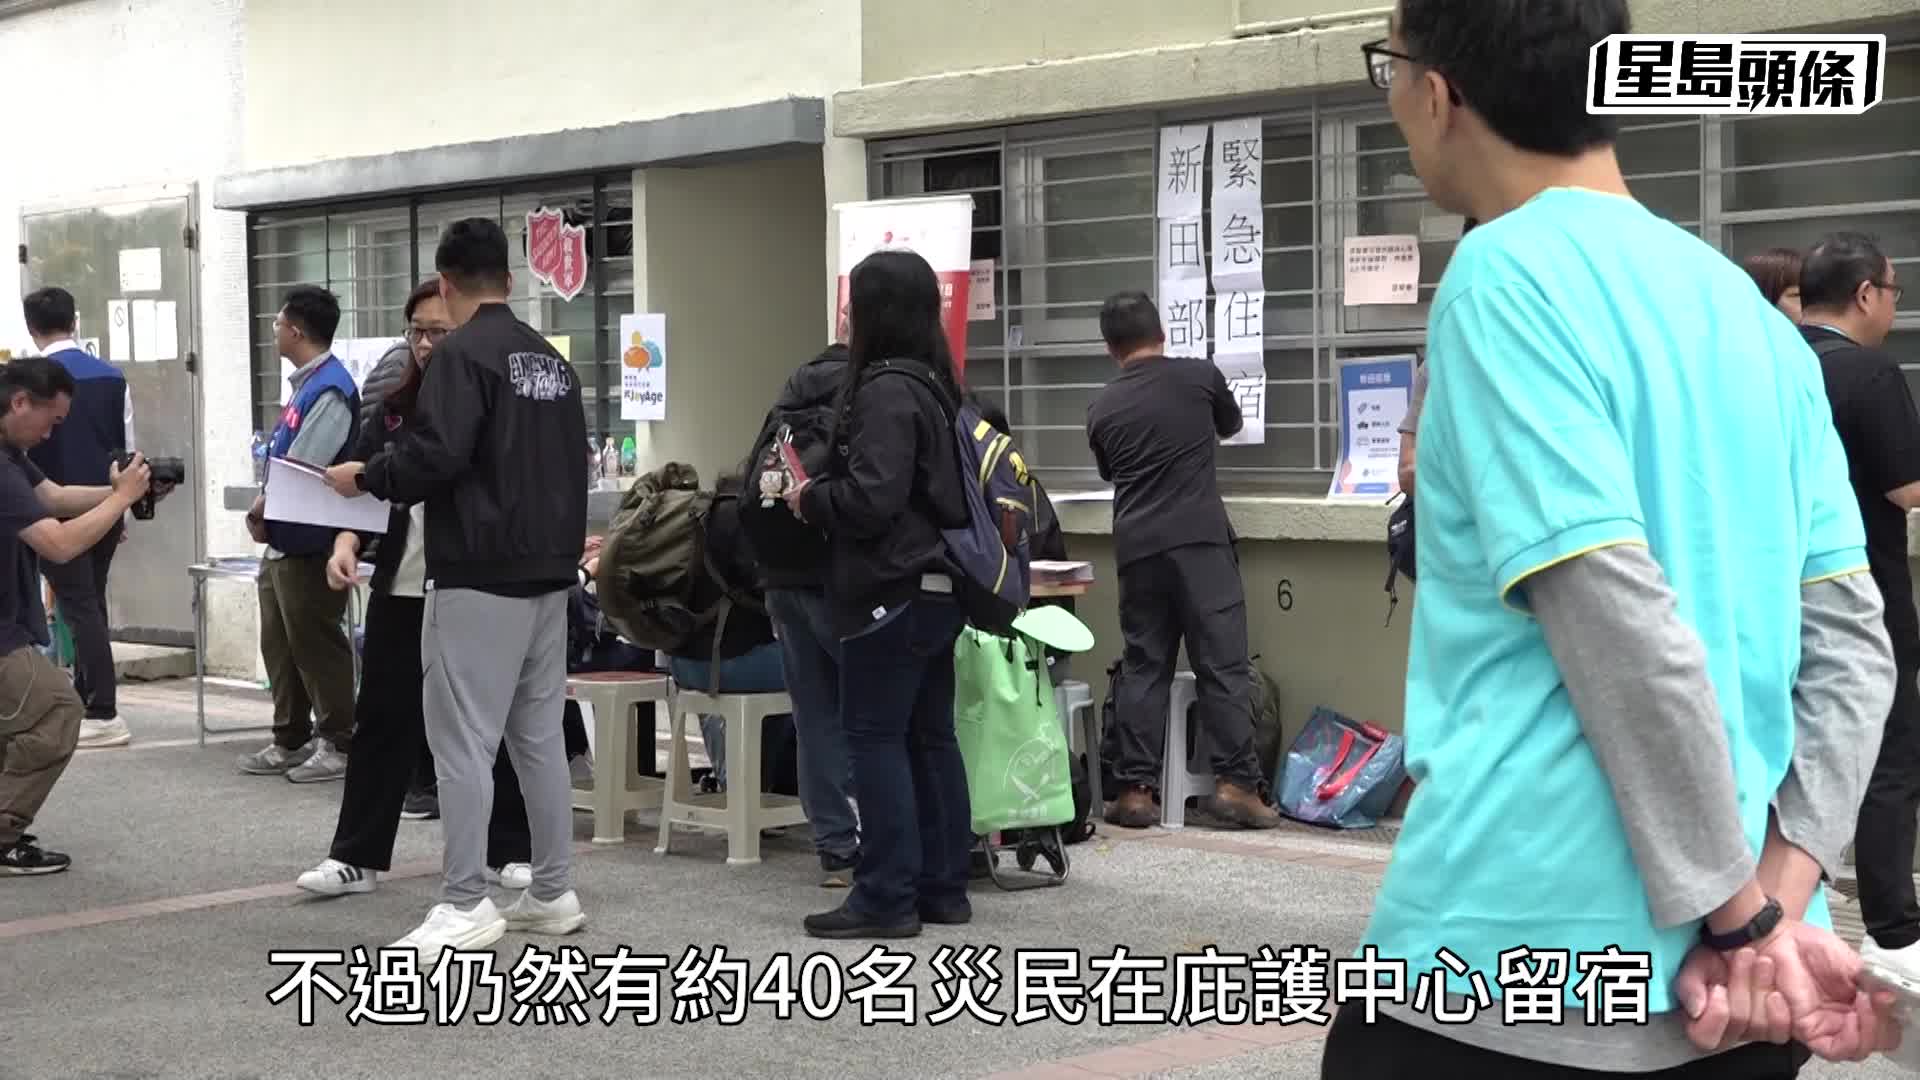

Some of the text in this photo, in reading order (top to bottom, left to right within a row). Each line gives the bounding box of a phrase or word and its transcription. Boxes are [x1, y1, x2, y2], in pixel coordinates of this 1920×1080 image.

[1167, 144, 1204, 347] 新田部
[1221, 138, 1264, 419] 緊急住宿
[1277, 579, 1293, 611] 6
